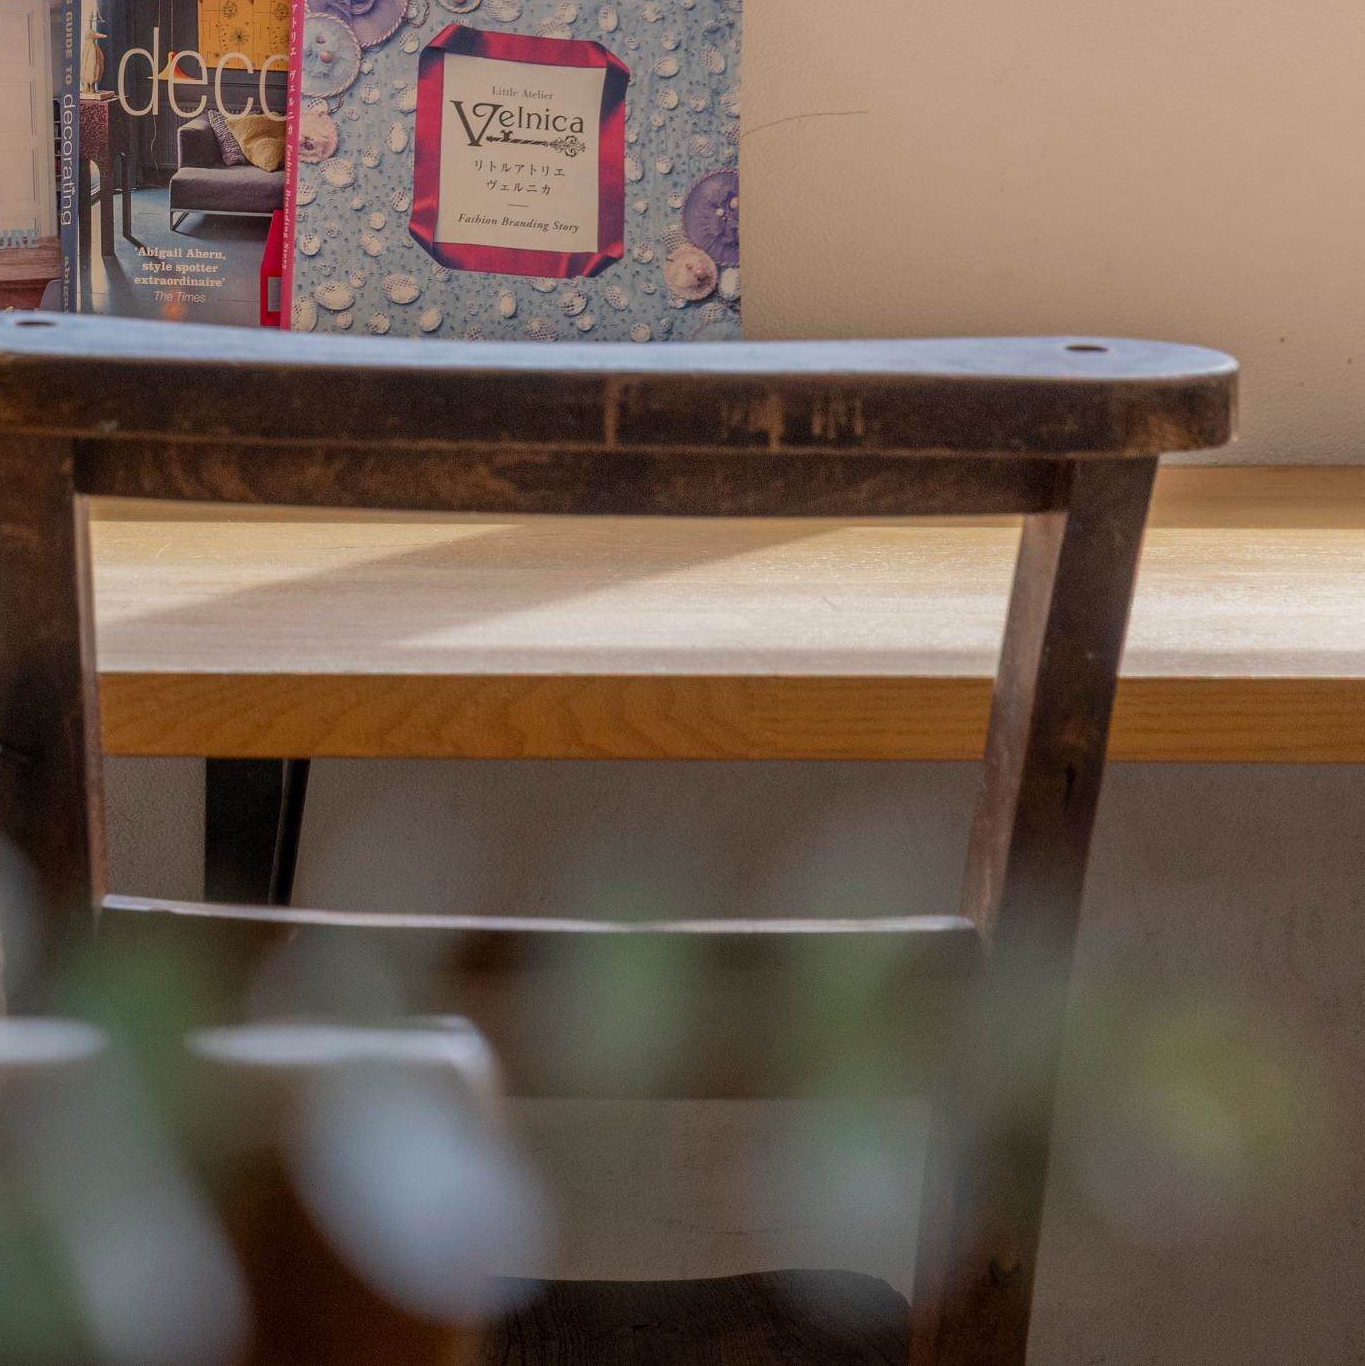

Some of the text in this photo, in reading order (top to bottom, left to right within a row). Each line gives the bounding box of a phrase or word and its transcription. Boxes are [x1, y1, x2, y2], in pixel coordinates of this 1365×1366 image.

[64, 11, 73, 59] GUIDE
[64, 64, 73, 86] TO
[492, 86, 554, 100] Little Atelier
[450, 100, 585, 147] Velnica
[61, 93, 76, 226] decorating
[474, 159, 566, 177] リトルアトリエ
[486, 179, 551, 195] ヴェルニカ
[457, 213, 580, 234] Fashion Branding Story
[135, 247, 182, 259] 'Abigail
[141, 262, 219, 274] style spotter
[134, 276, 226, 287] extraordinaire'
[154, 290, 206, 303] The Times
